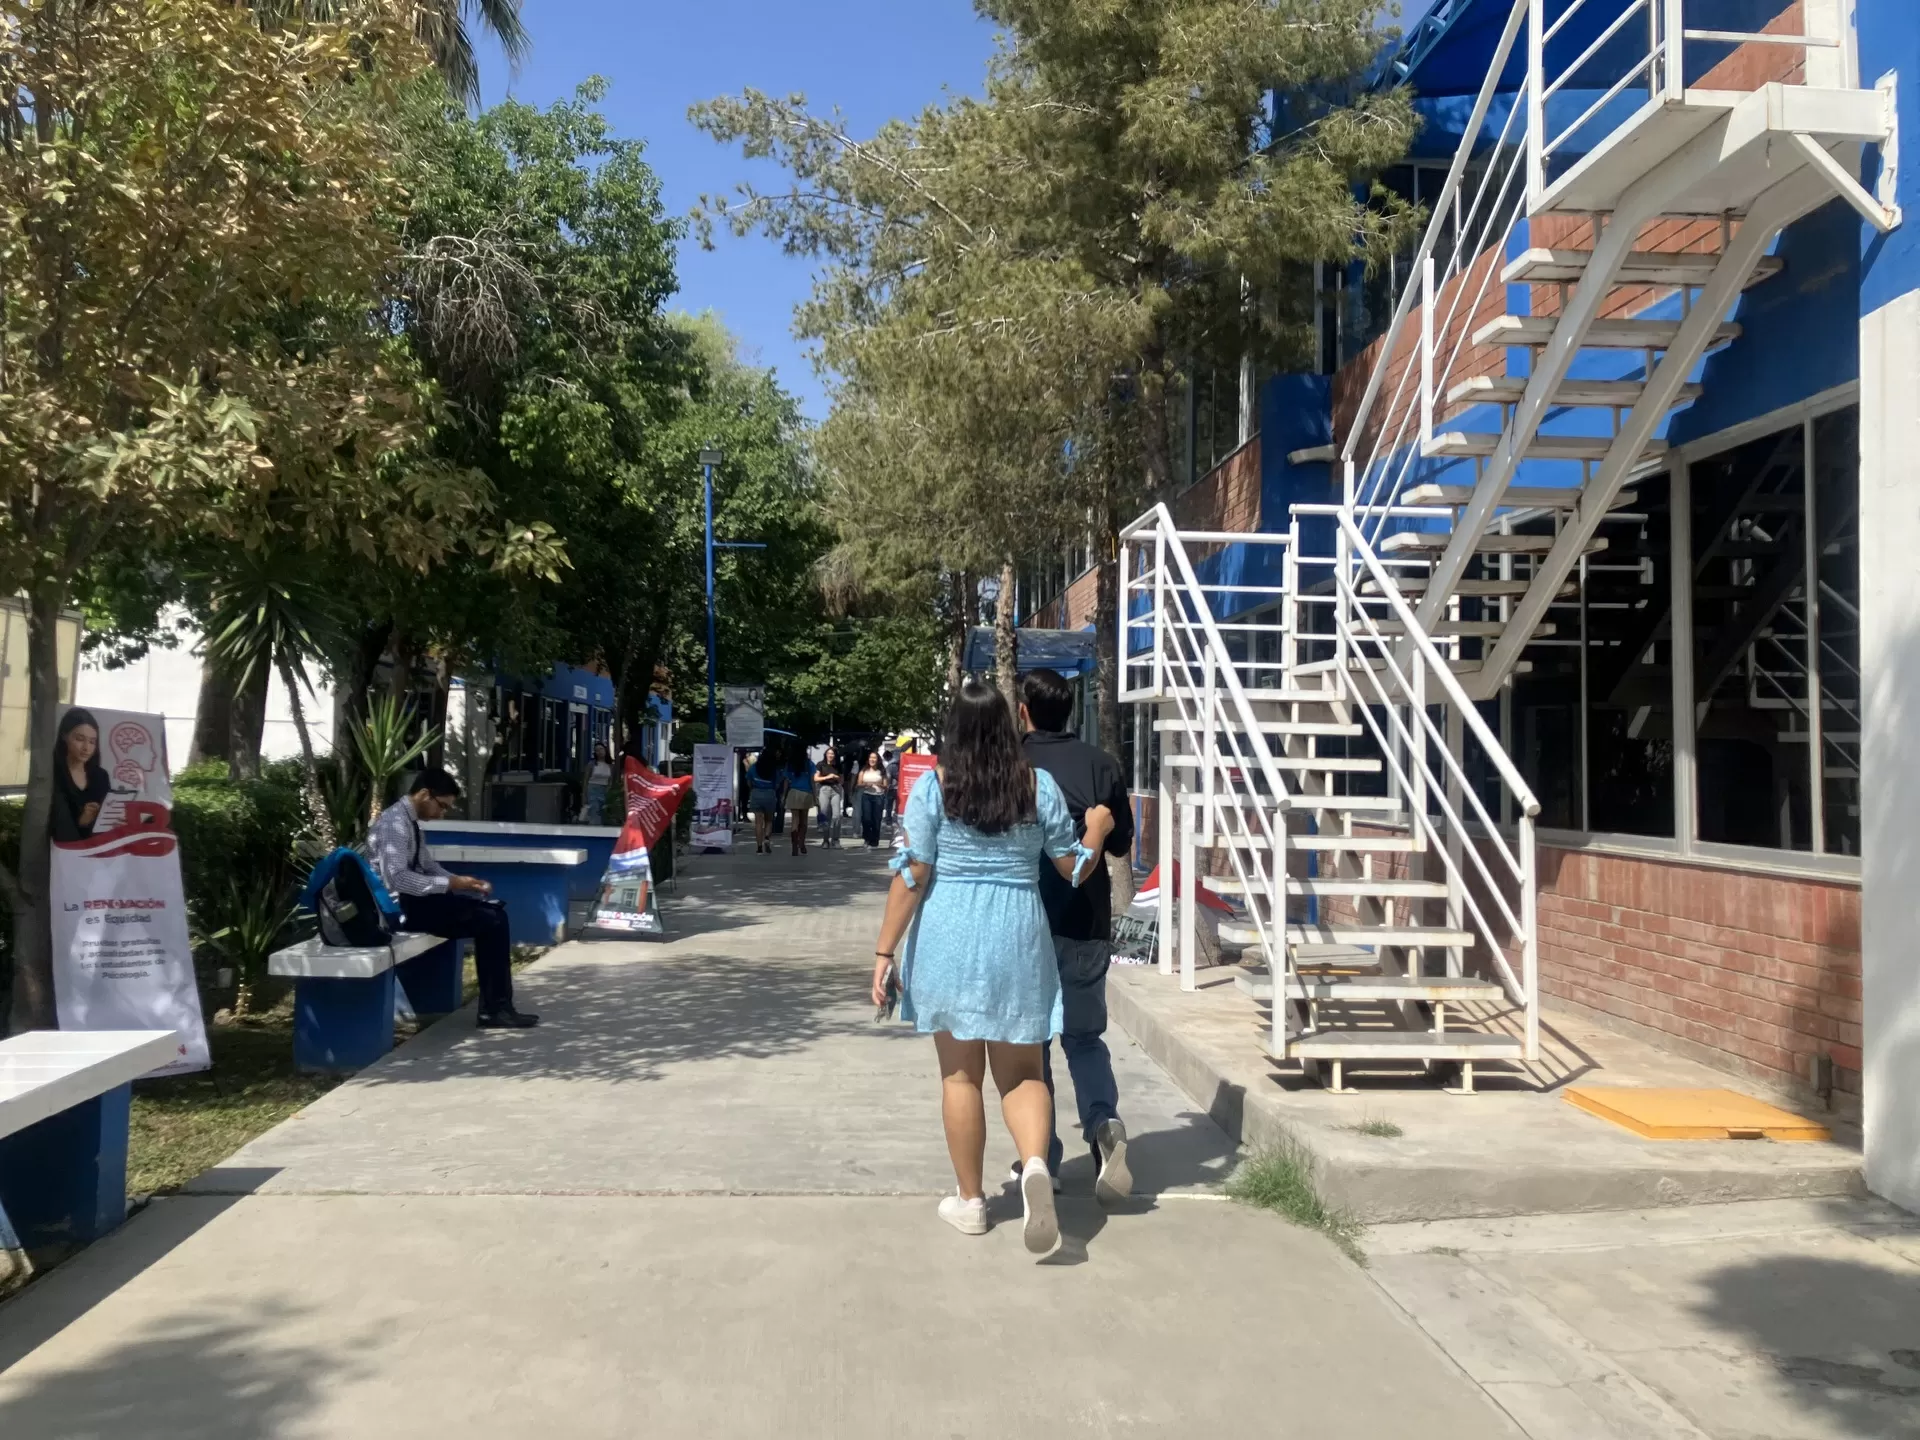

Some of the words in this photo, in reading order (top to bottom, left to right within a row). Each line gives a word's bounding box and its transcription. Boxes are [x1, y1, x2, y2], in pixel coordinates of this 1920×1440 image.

[63, 902, 79, 912] La
[85, 916, 100, 924] es
[104, 914, 152, 925] Equidad
